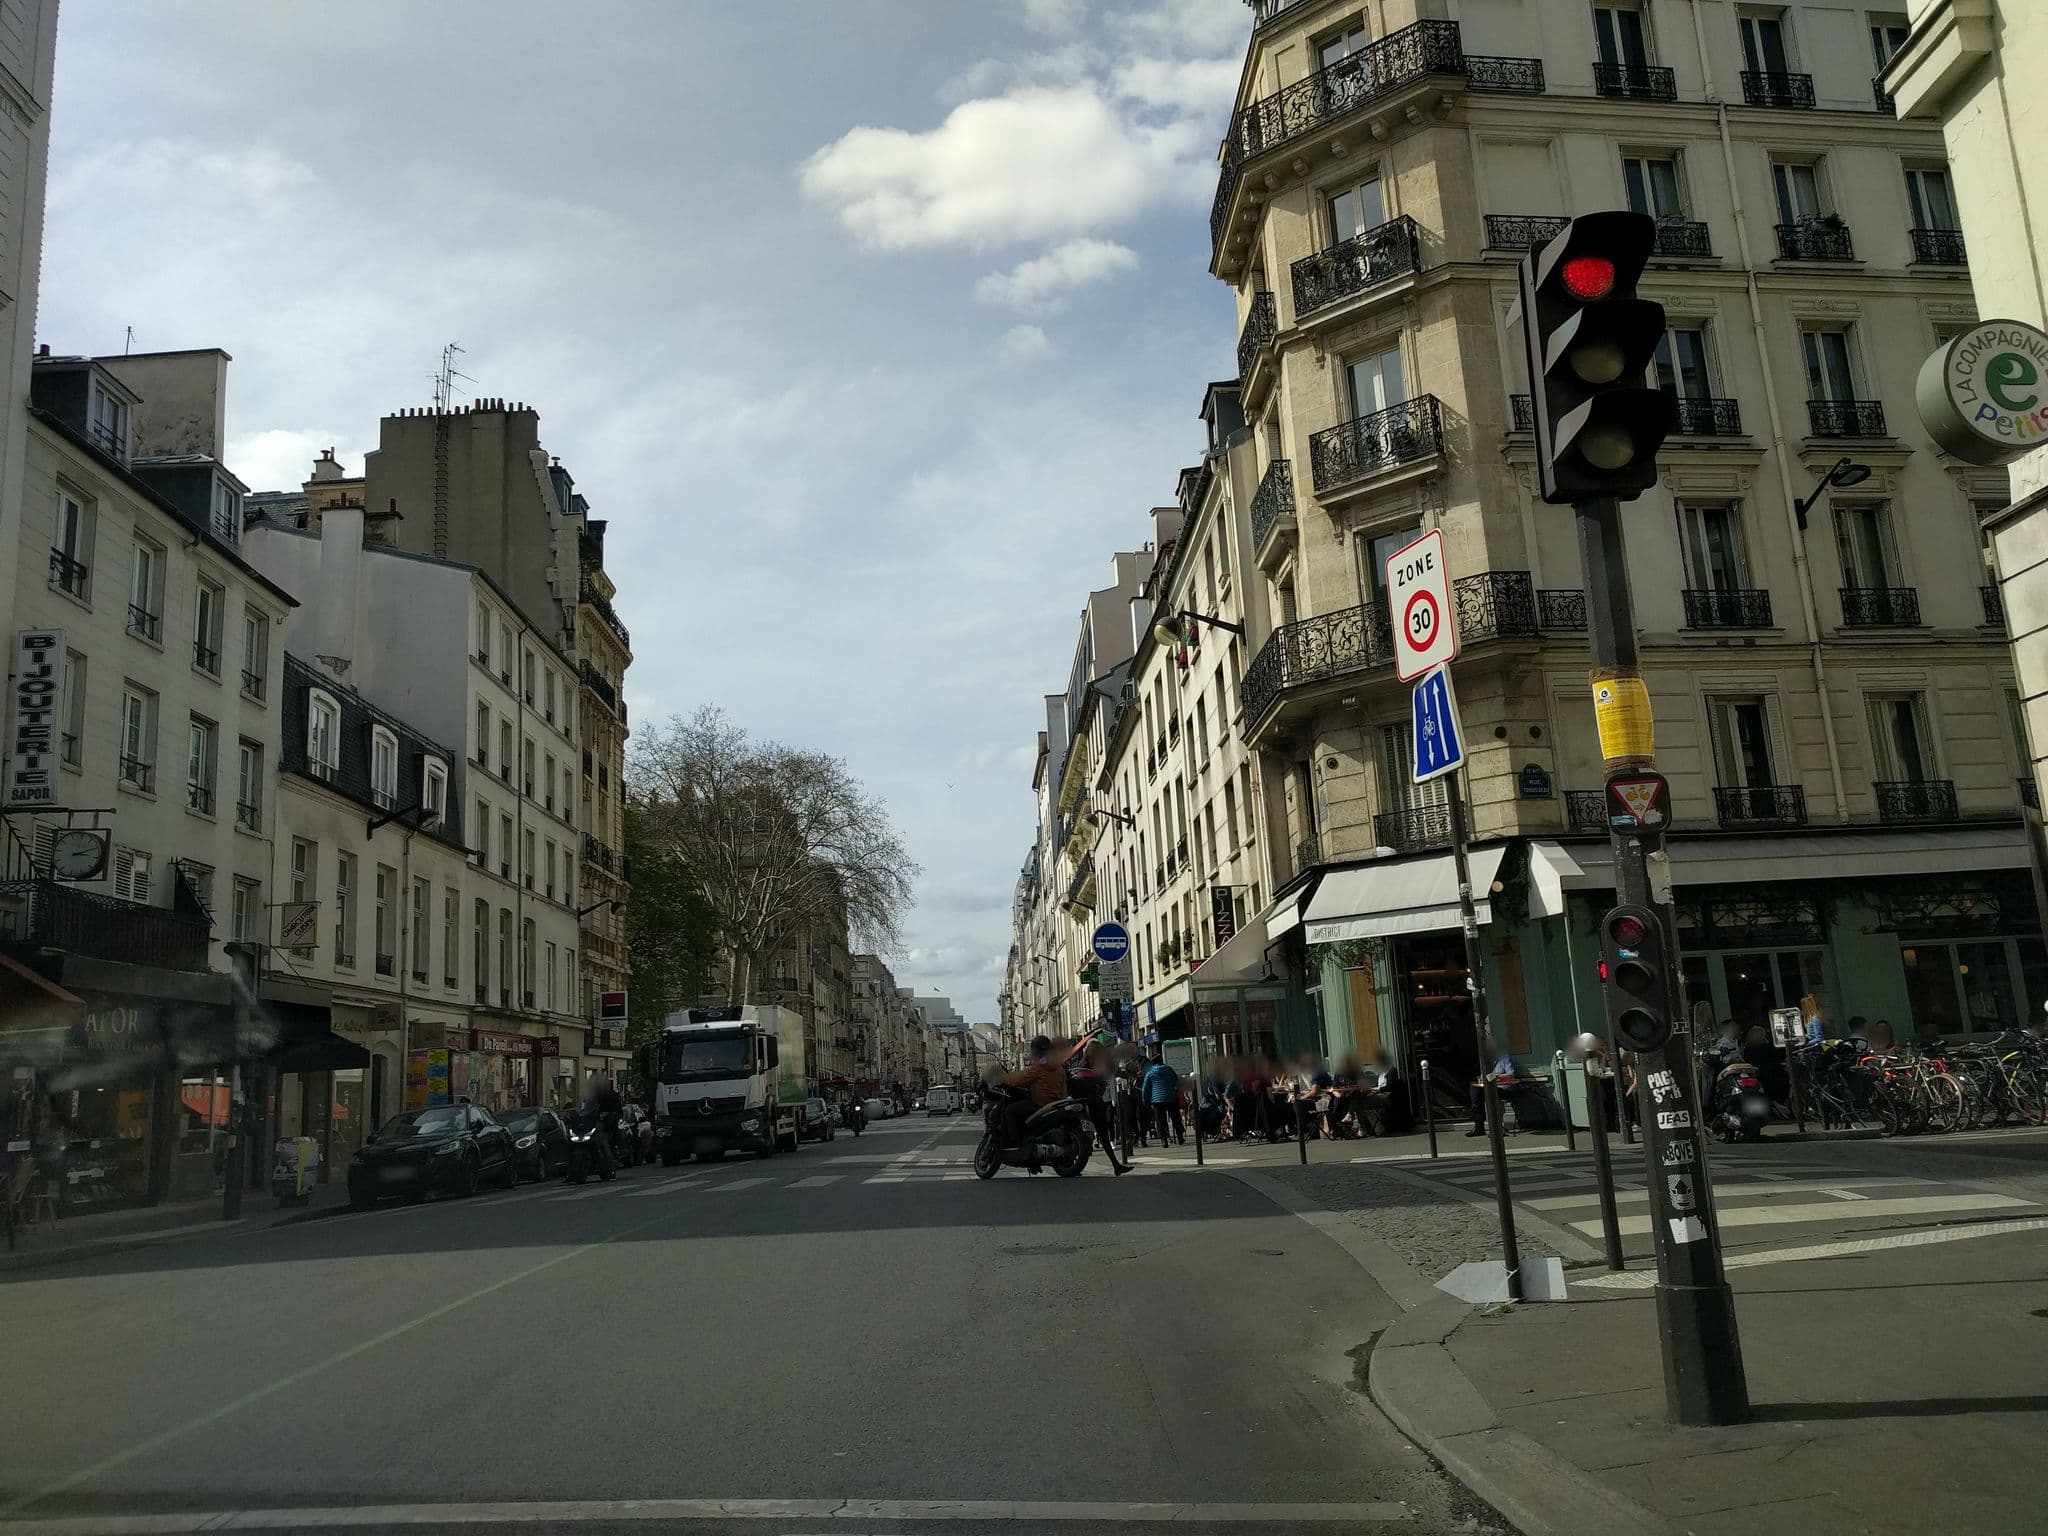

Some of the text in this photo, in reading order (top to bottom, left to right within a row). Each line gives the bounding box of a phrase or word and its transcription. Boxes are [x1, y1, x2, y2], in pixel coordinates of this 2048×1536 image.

[1955, 329, 2048, 405] LA COMPAGNIE
[1397, 552, 1434, 588] ZONE
[1412, 608, 1431, 635] 30
[15, 634, 57, 787] BIJOUTERIE
[11, 787, 50, 802] SAPOR
[1314, 924, 1341, 940] DISTRICT
[1659, 1112, 1688, 1125] JEAS
